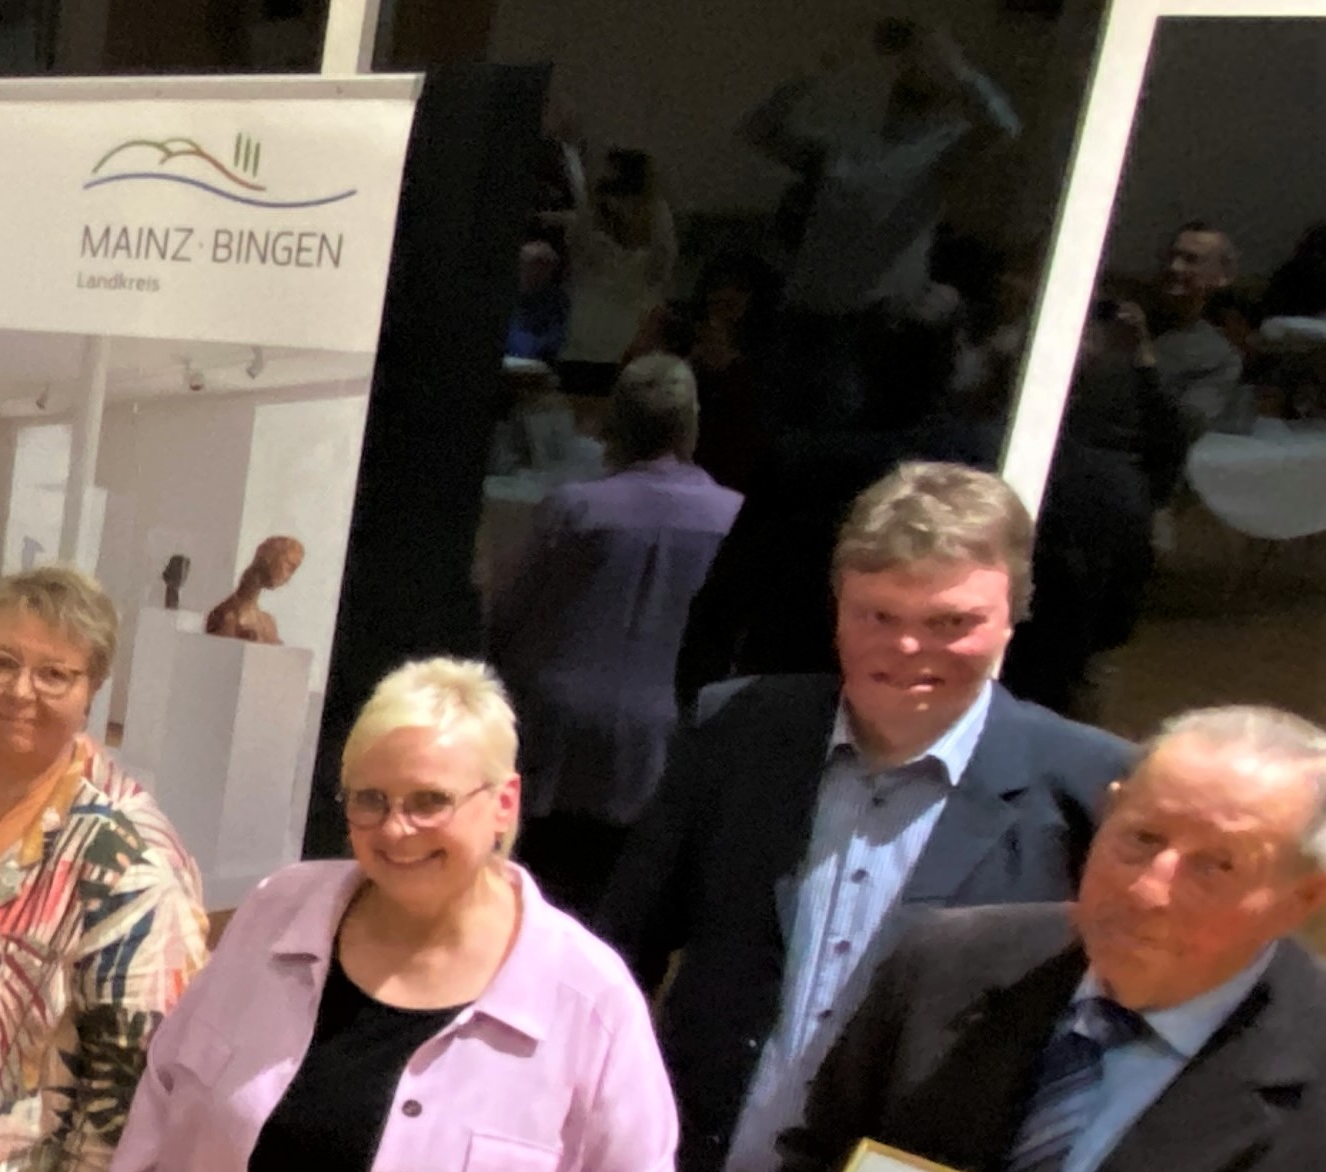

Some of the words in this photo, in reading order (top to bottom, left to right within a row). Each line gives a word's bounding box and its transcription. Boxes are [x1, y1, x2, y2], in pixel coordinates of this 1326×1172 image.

[80, 224, 195, 262] MAINZ
[210, 228, 344, 269] BINGEN
[76, 271, 161, 292] Landkreis
